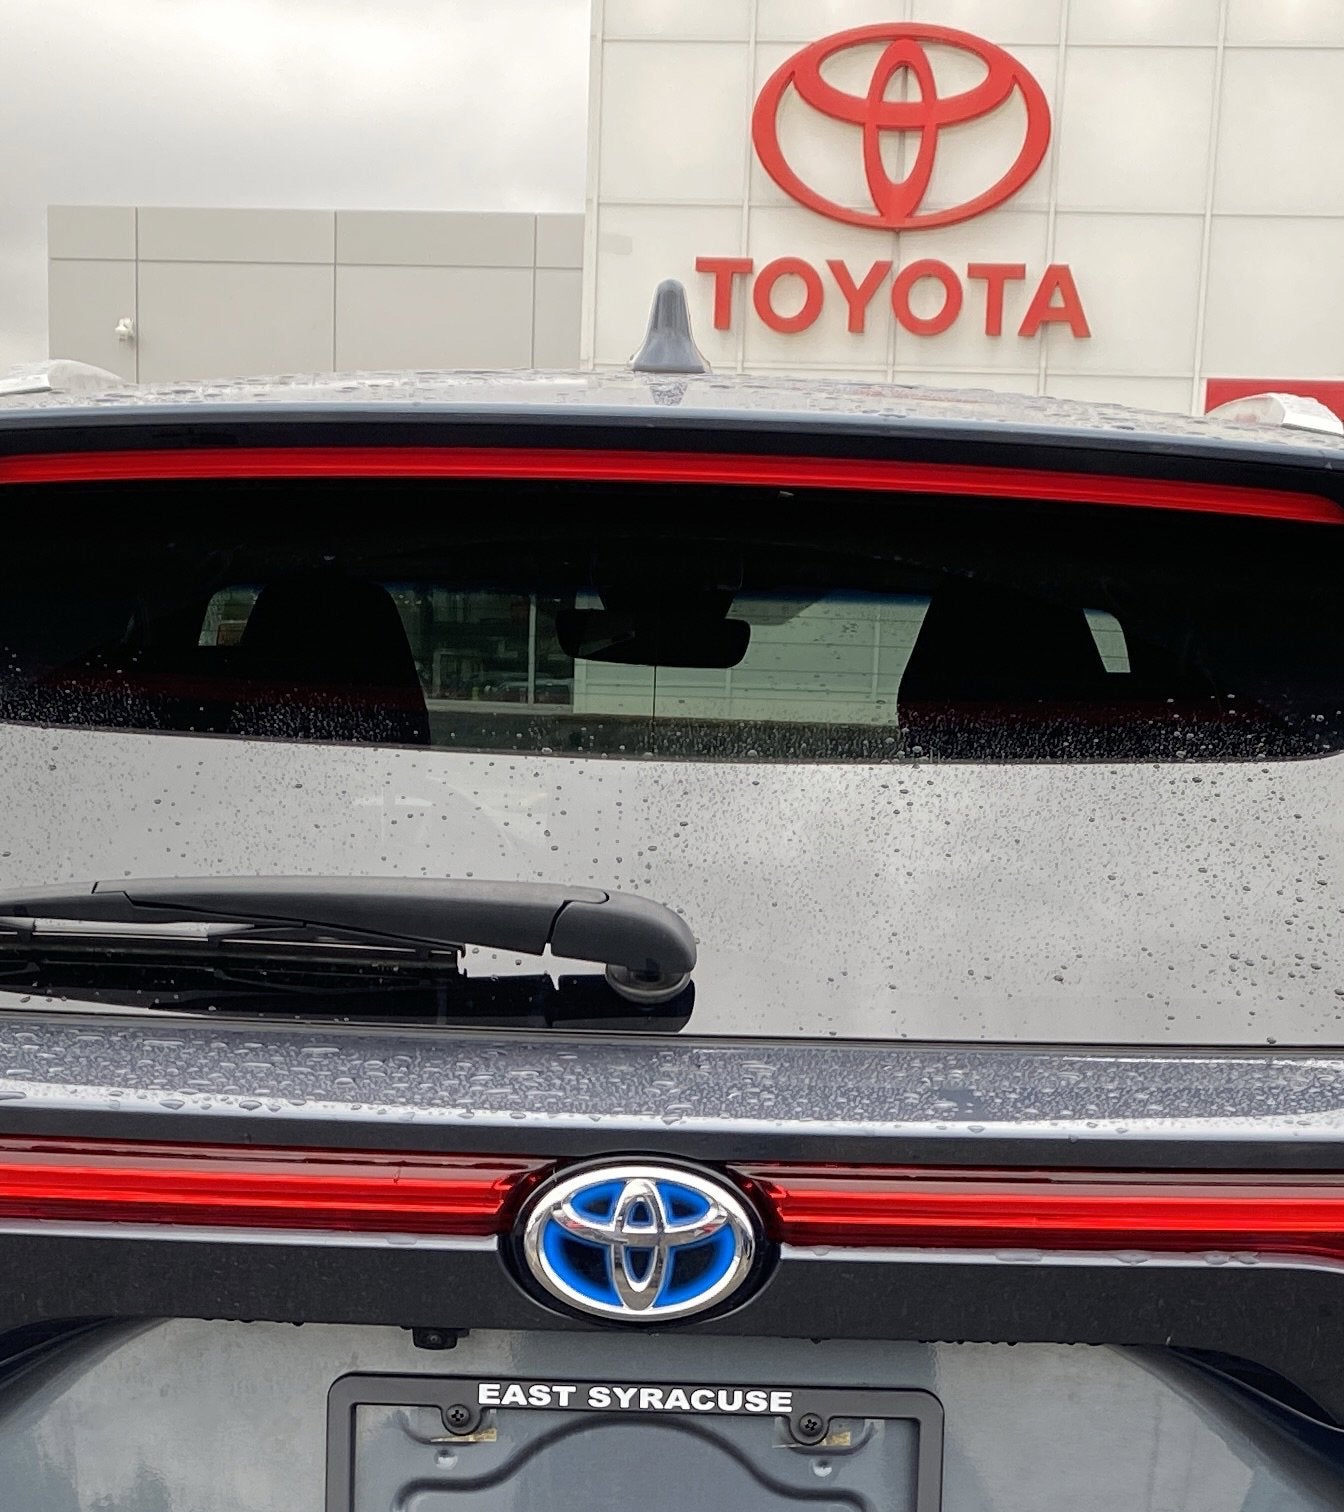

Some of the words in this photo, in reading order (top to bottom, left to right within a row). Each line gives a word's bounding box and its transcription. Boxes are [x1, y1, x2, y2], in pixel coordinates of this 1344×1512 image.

[695, 256, 1092, 339] TOYOTA
[478, 1383, 577, 1407] EAST
[588, 1386, 793, 1413] SYRACUSE
